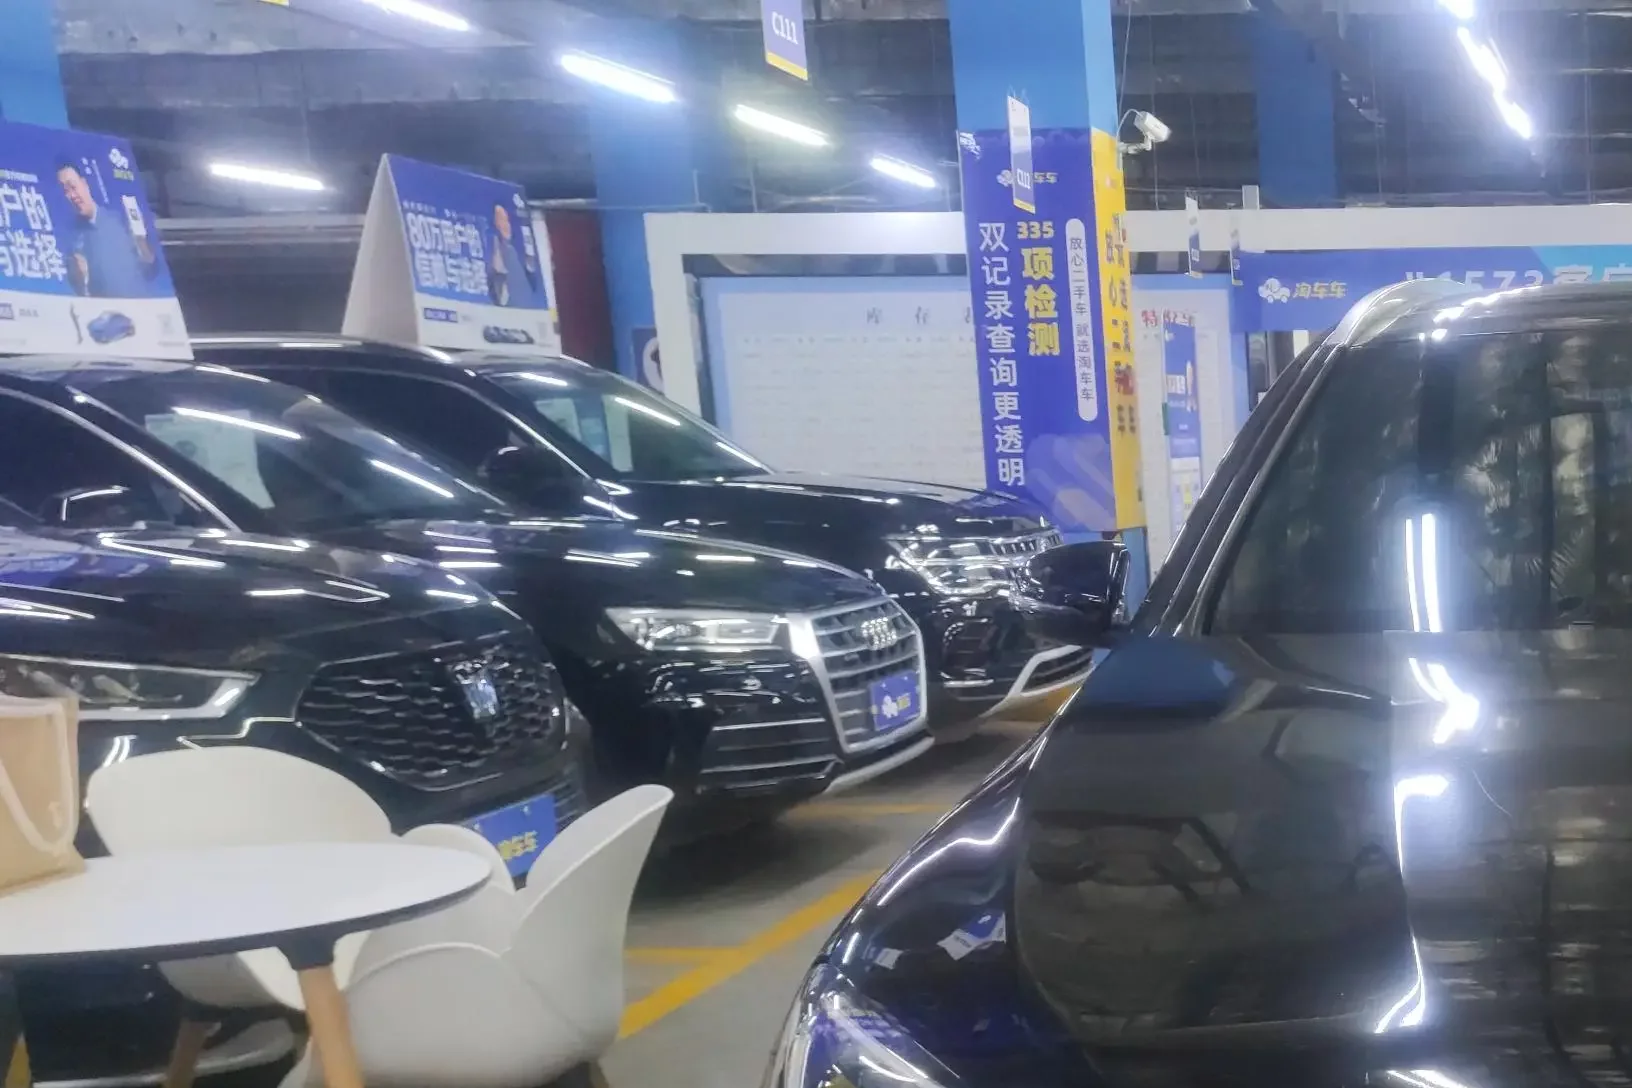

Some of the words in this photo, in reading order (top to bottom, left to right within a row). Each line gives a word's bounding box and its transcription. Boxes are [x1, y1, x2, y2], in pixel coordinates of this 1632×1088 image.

[771, 11, 799, 45] C111
[1069, 236, 1088, 316] 放心二手车
[1293, 280, 1348, 299] 淘车车
[978, 222, 1025, 487] 双记录查询更透明
